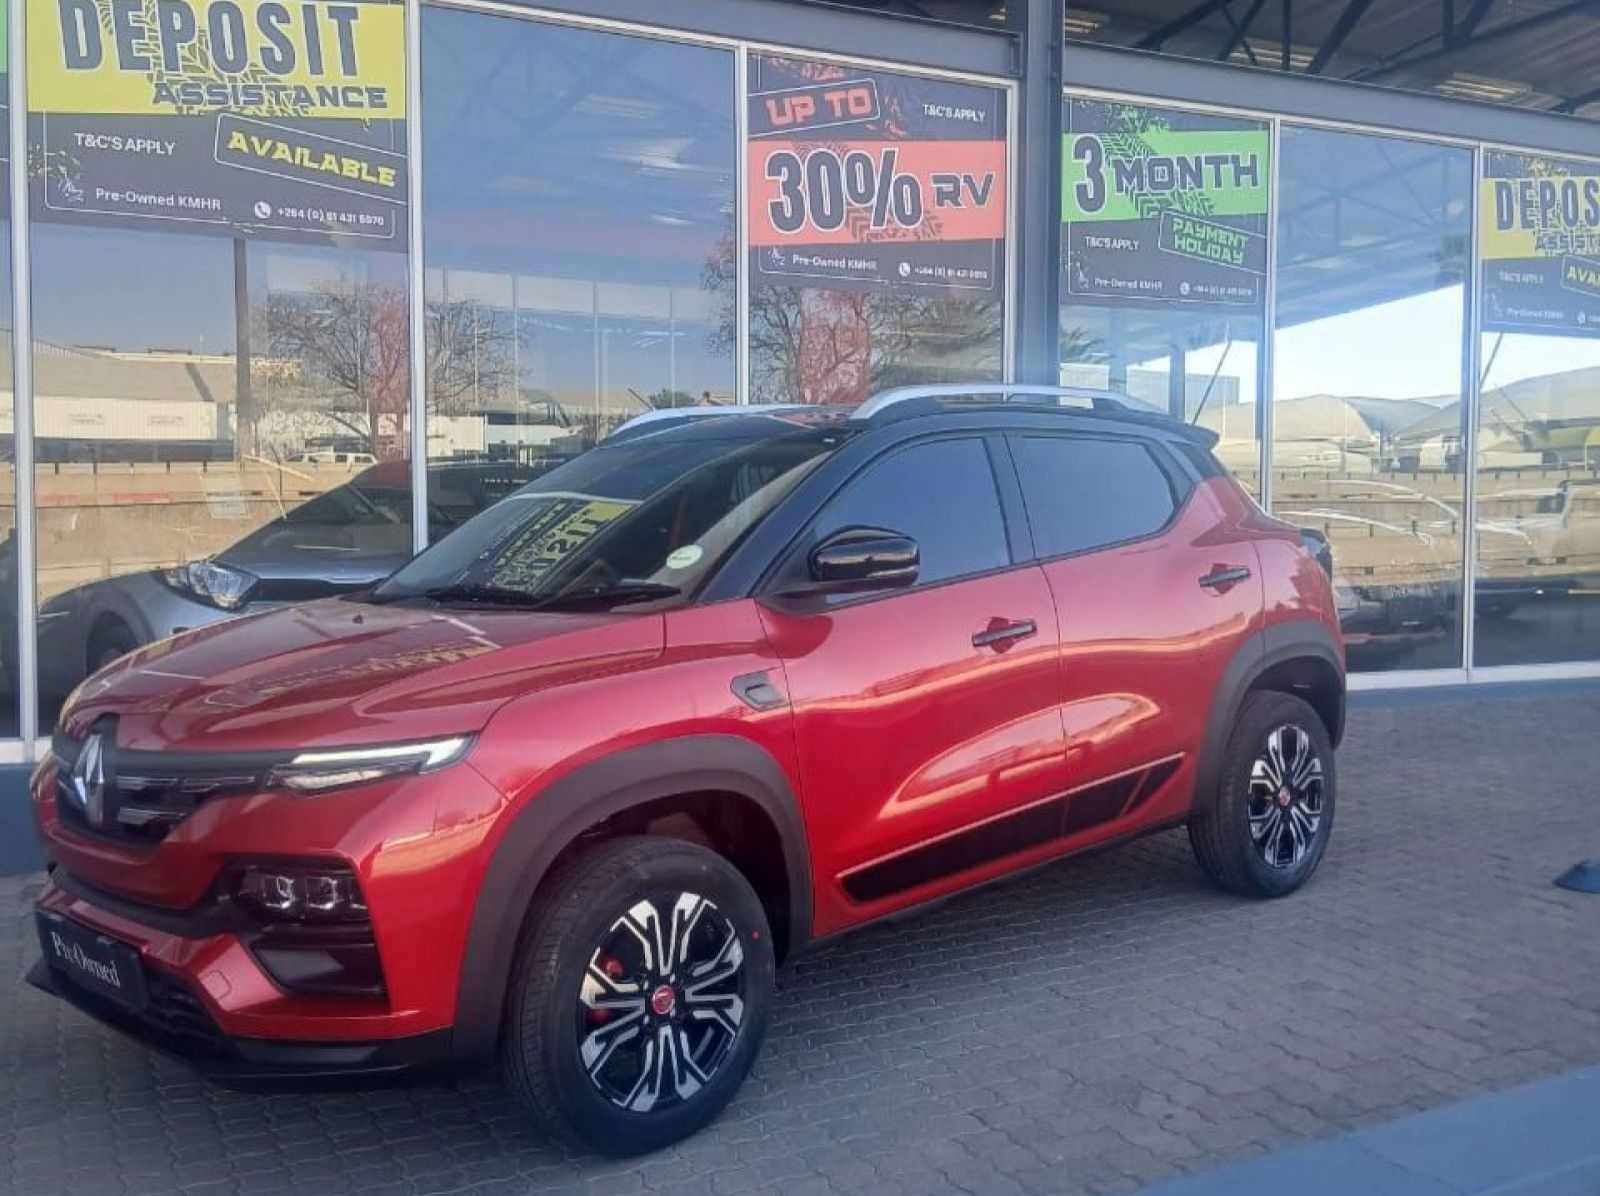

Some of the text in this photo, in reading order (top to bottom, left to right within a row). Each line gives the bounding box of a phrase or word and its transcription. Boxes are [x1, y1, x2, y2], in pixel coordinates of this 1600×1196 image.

[58, 0, 360, 77] DEPOSIT
[152, 81, 389, 109] ASSISTANCE
[766, 87, 873, 126] UP TO
[953, 107, 985, 122] APPLY
[74, 132, 176, 156] T&C'S APPLY
[227, 131, 396, 187] AVAILABLE
[1072, 134, 1260, 214] 3 MONTH
[96, 187, 221, 211] Pre-Owned KMHR
[764, 147, 996, 234] 30% RV
[1172, 217, 1249, 247] PAYMENT
[1173, 234, 1244, 266] HOLIDAY
